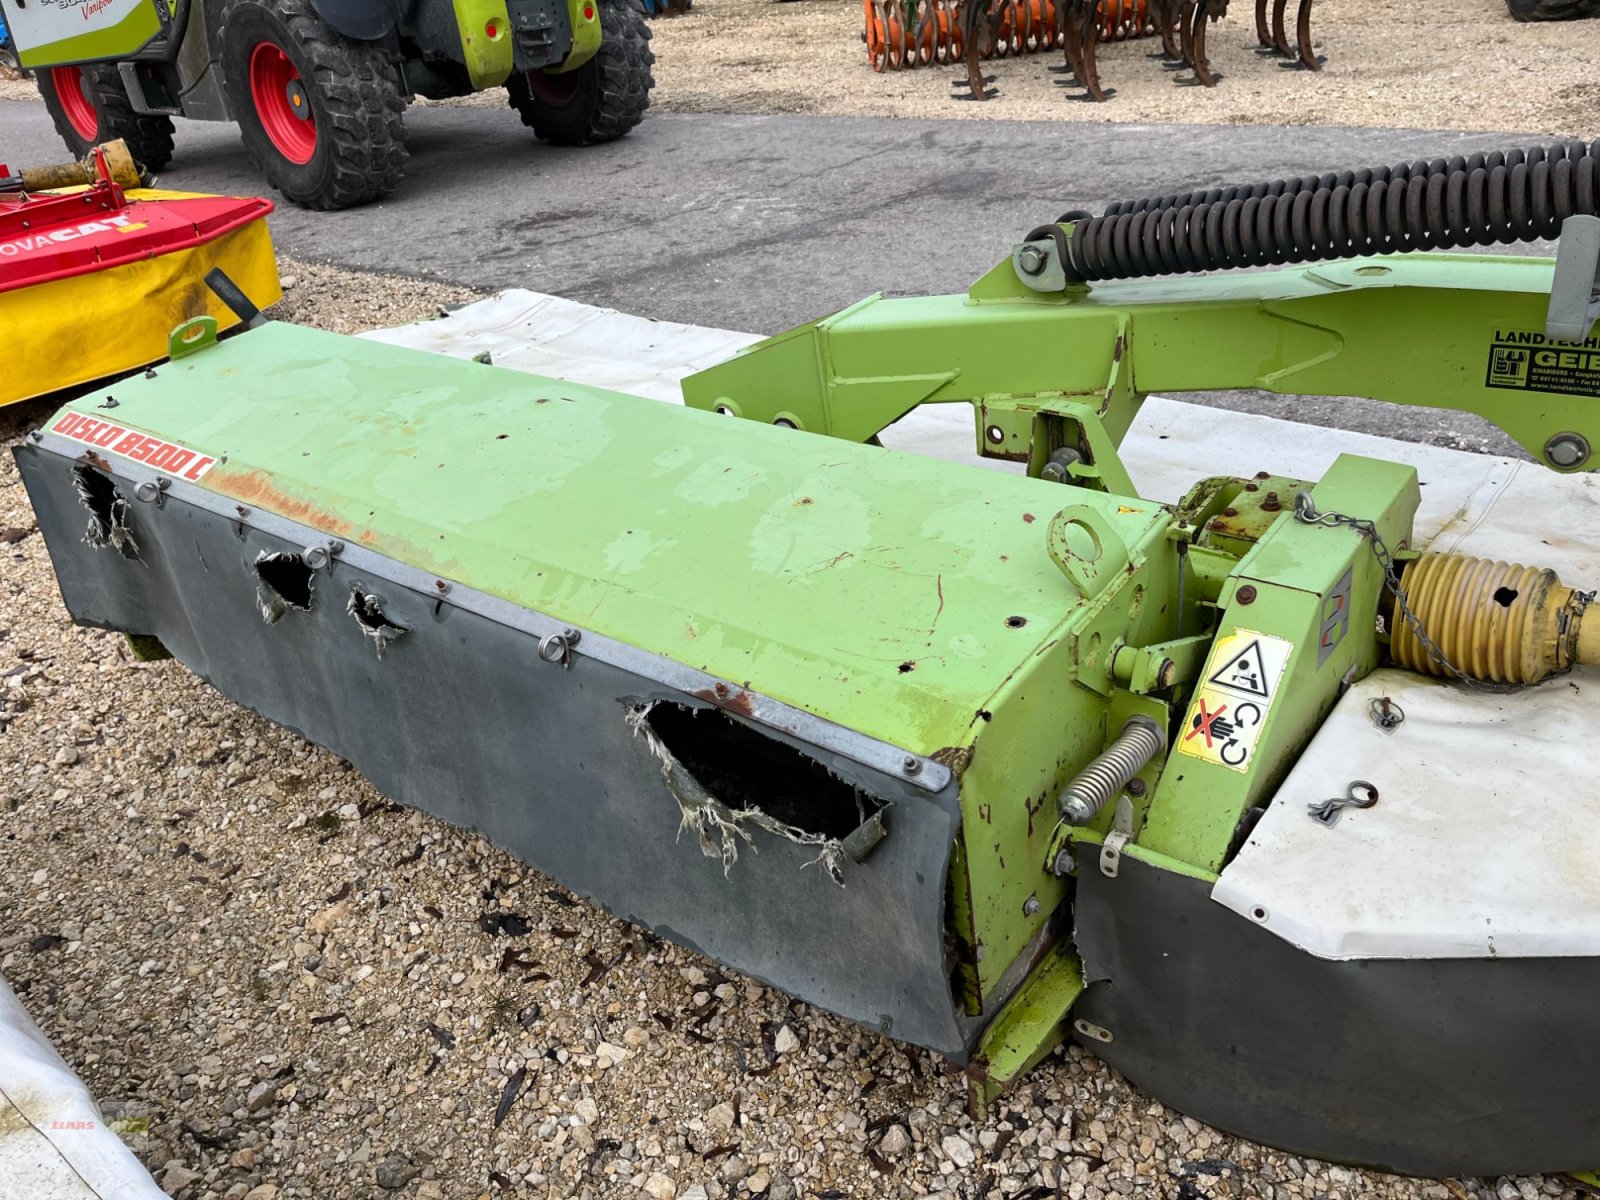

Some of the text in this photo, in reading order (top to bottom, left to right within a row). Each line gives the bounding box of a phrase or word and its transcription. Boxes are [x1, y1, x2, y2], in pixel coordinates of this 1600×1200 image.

[52, 412, 215, 480] DISCO 8500 C
